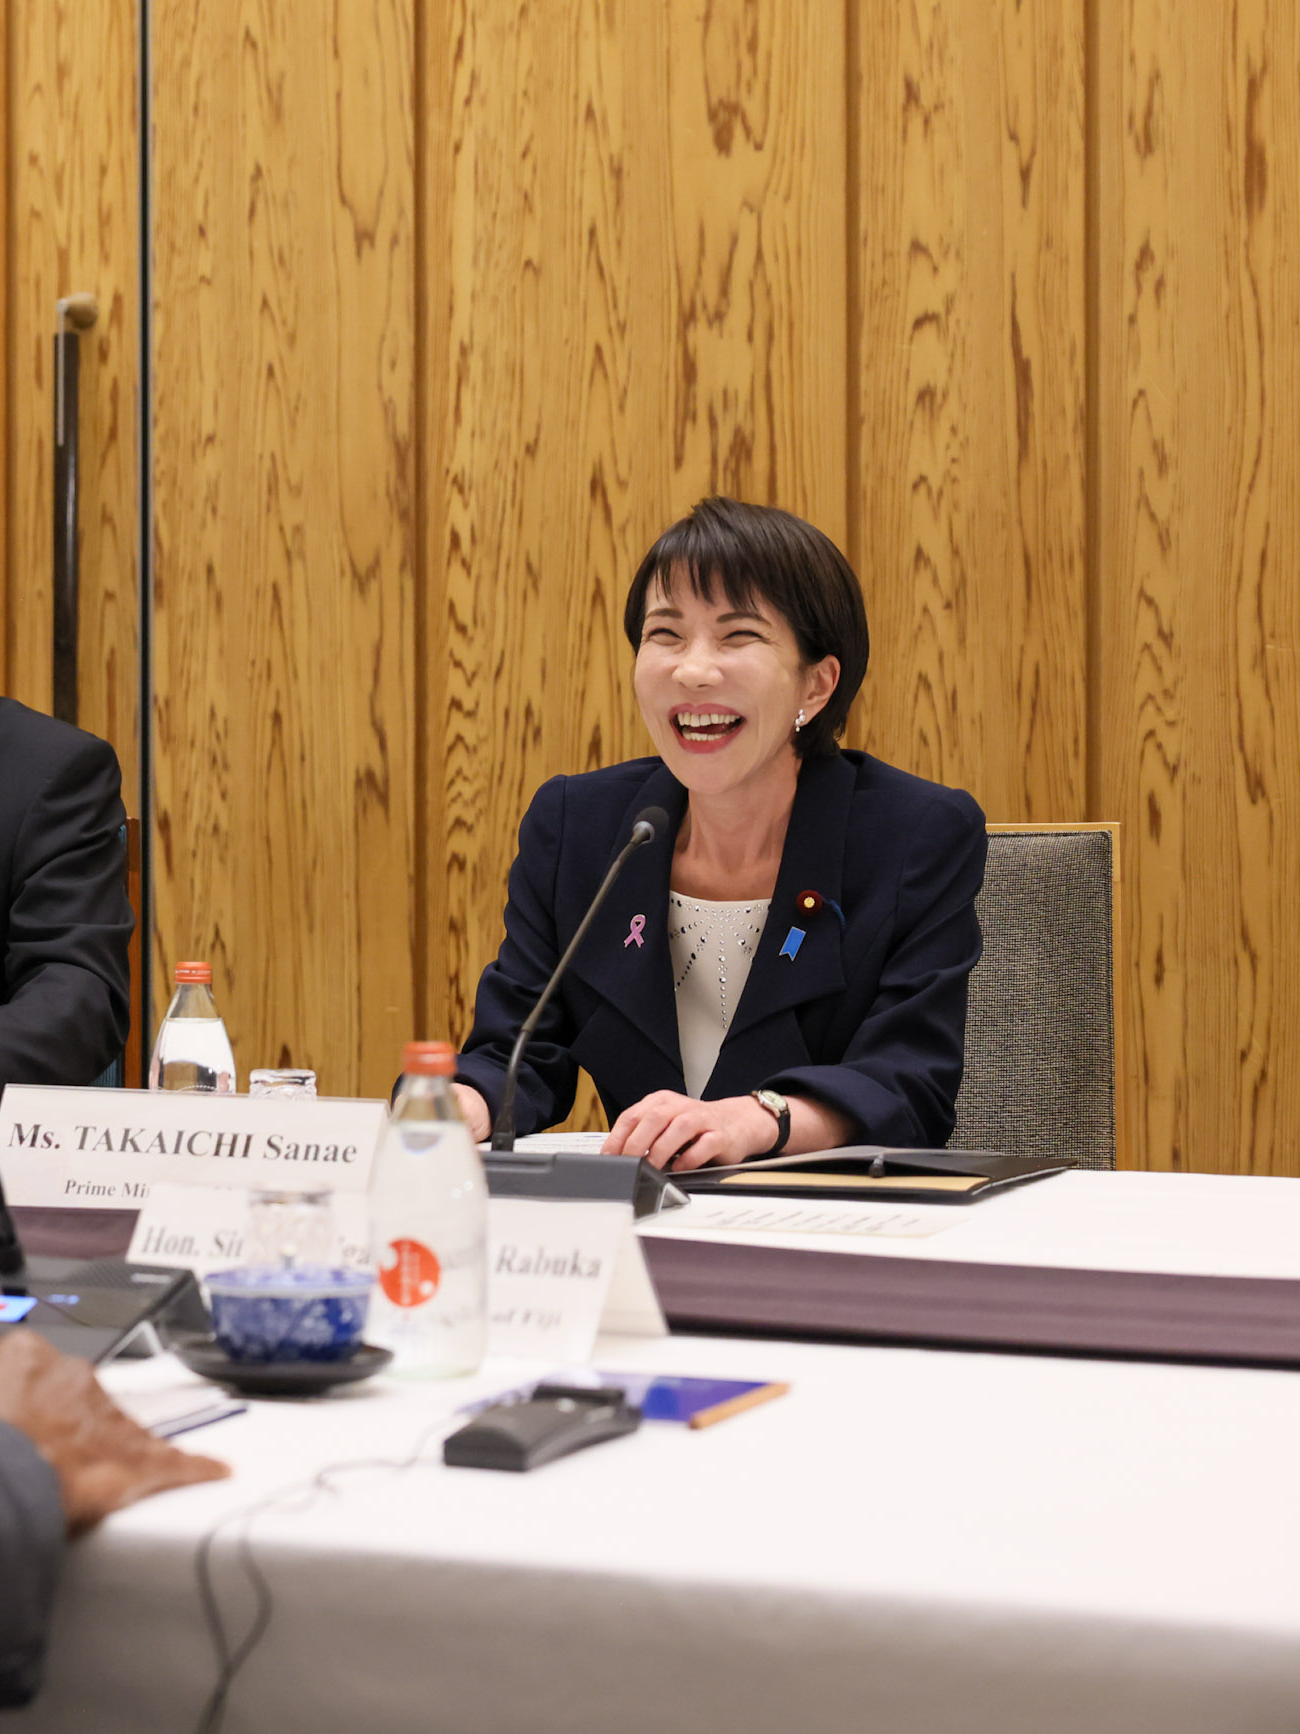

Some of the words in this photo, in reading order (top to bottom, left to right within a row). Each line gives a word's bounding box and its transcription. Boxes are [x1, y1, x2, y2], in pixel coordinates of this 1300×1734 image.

[7, 1122, 61, 1150] Ms.
[74, 1125, 255, 1159] TAKAICHI
[262, 1133, 358, 1164] Sanae
[64, 1179, 116, 1197] Prime
[141, 1225, 200, 1257] Hon.
[495, 1243, 603, 1279] Rabuka
